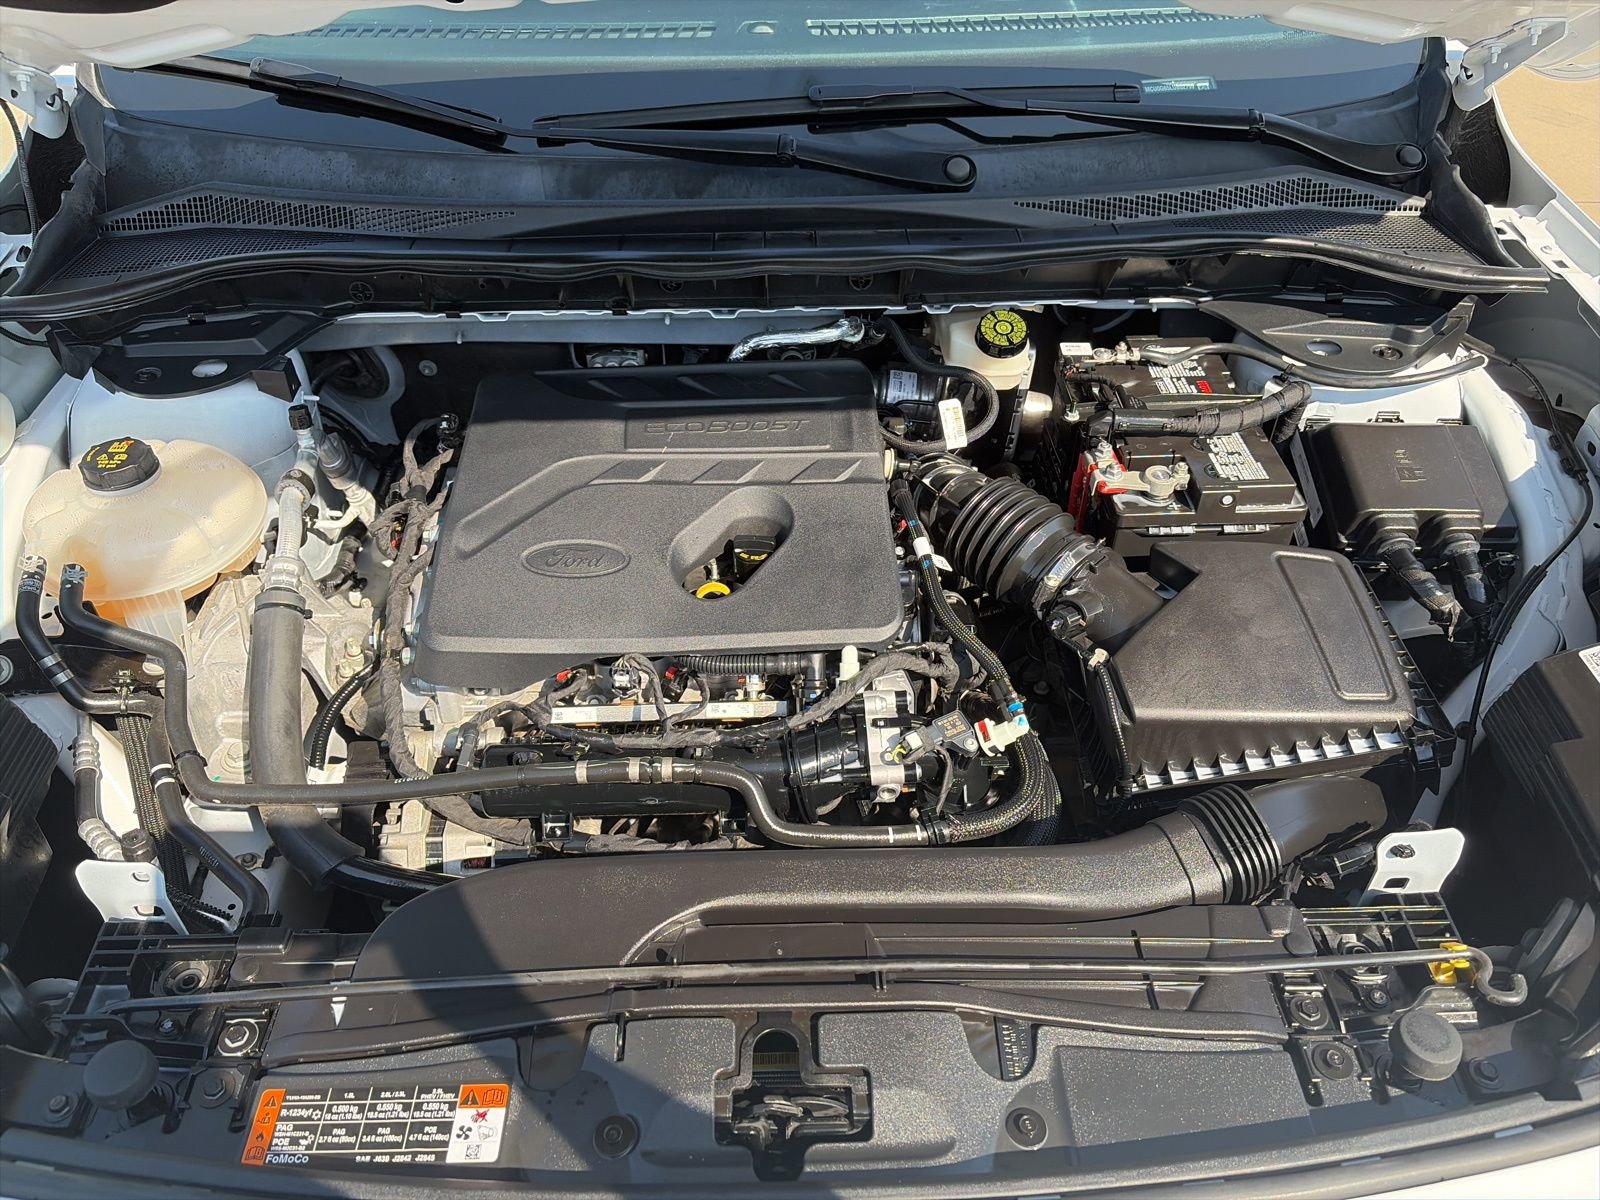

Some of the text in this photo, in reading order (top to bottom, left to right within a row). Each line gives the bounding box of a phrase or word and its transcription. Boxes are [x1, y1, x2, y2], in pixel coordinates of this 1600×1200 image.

[644, 419, 811, 435] ECOBOOST
[545, 548, 605, 568] Ford
[332, 1105, 359, 1114] 0.500 kg
[394, 1103, 403, 1112] kg
[440, 1103, 449, 1111] kg
[280, 1108, 313, 1118] R-1234yf
[276, 1124, 294, 1132] PAG
[272, 1138, 290, 1146] POE
[265, 1154, 309, 1164] FoMoCo
